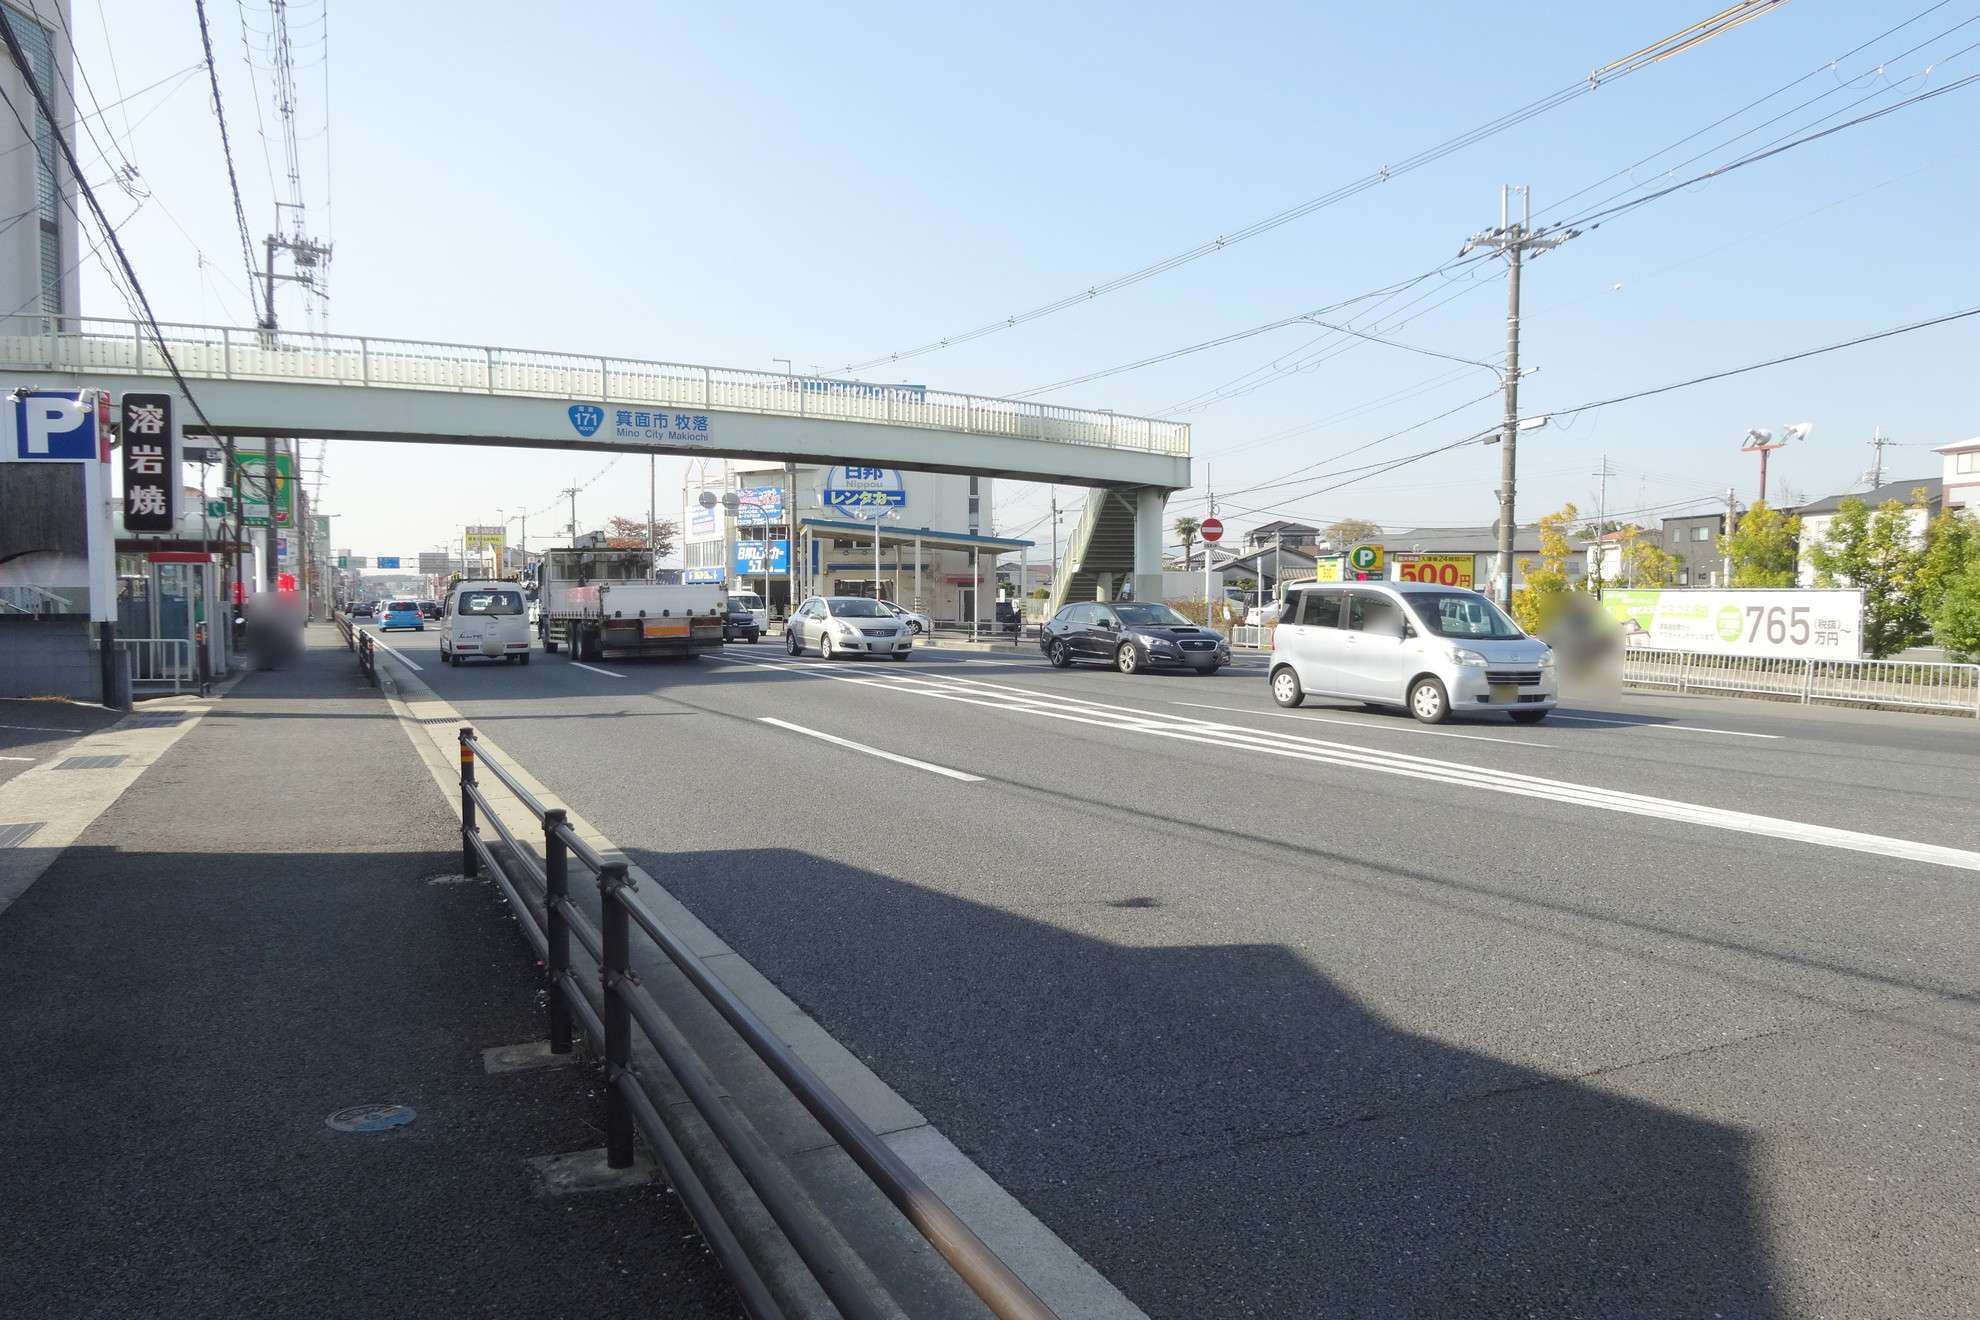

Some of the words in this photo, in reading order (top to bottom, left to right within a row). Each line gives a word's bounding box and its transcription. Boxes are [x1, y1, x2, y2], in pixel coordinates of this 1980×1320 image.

[26, 397, 84, 454] P
[574, 413, 598, 426] 171
[615, 409, 669, 429] 箕面市
[675, 414, 709, 431] 牧落
[616, 428, 640, 439] Mino
[645, 430, 664, 441] City
[668, 431, 709, 442] Makiochi
[128, 404, 166, 516] 溶岩焼
[847, 480, 883, 489] Nippou
[830, 491, 902, 505] レンタカー
[1359, 550, 1374, 566] P
[1400, 563, 1459, 586] 500
[1459, 574, 1471, 587] 円
[1746, 606, 1811, 646] 765
